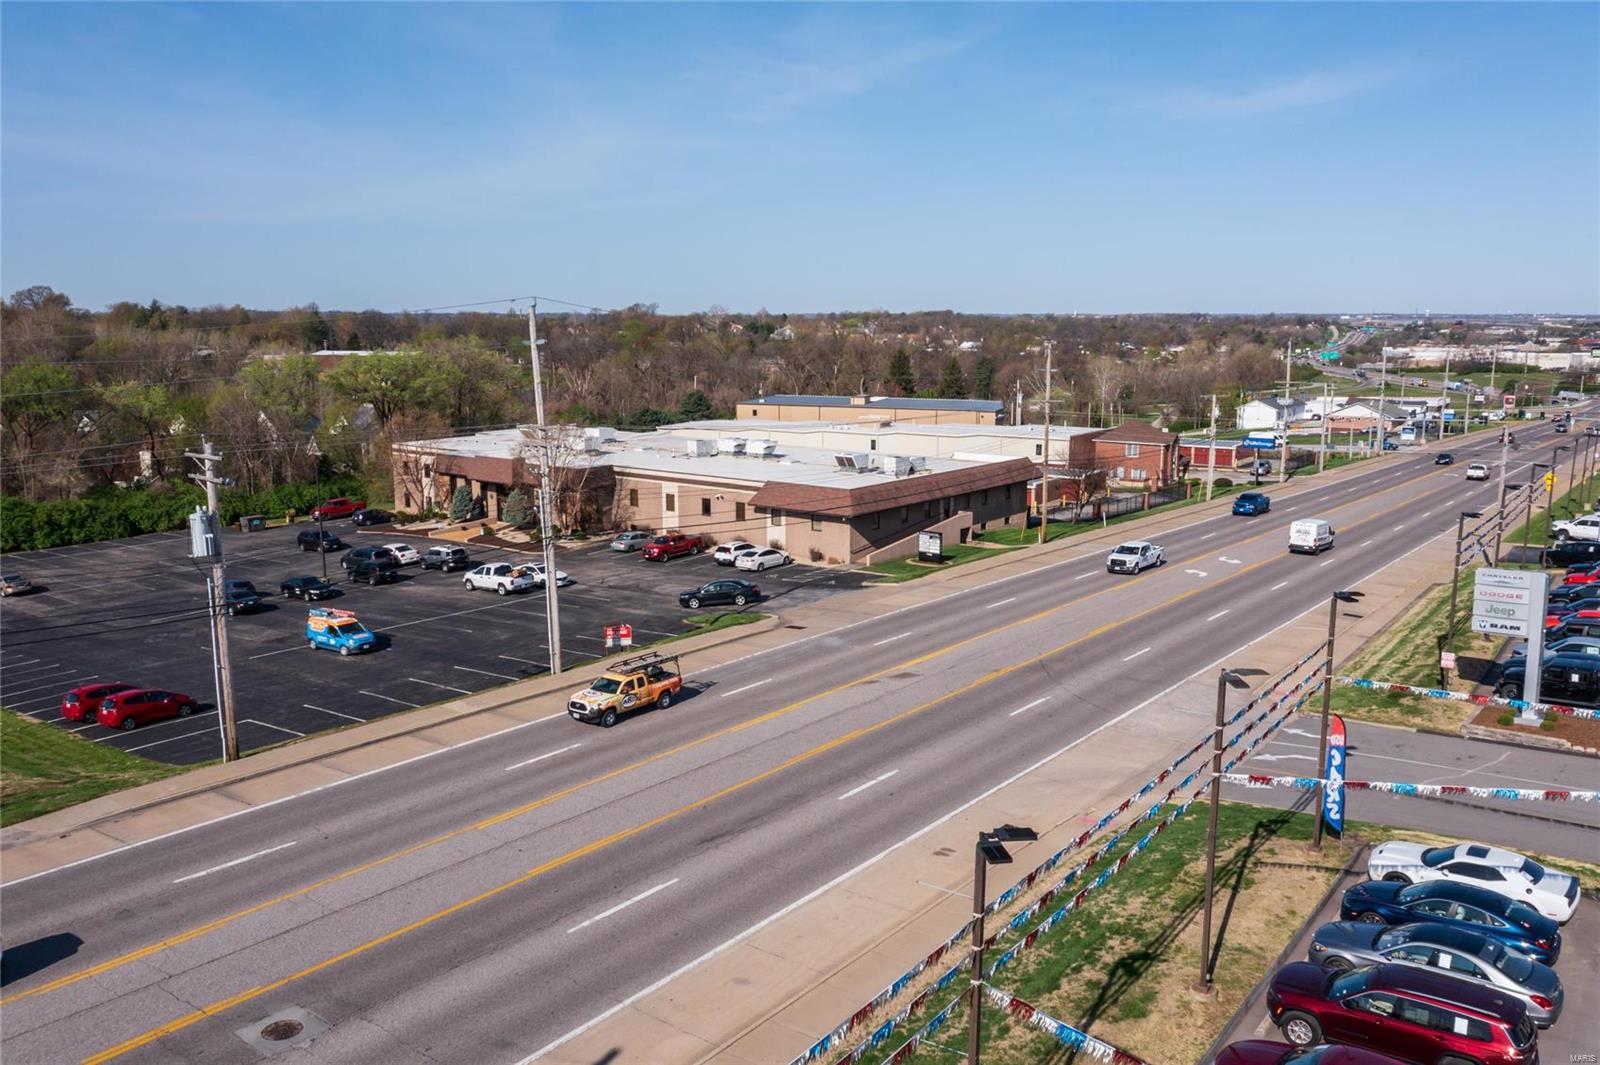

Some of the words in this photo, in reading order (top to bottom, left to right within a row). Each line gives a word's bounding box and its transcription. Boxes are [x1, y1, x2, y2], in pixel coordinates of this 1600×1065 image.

[1479, 591, 1523, 599] DODGE
[1485, 604, 1516, 617] Jeep
[1490, 623, 1521, 631] RAM
